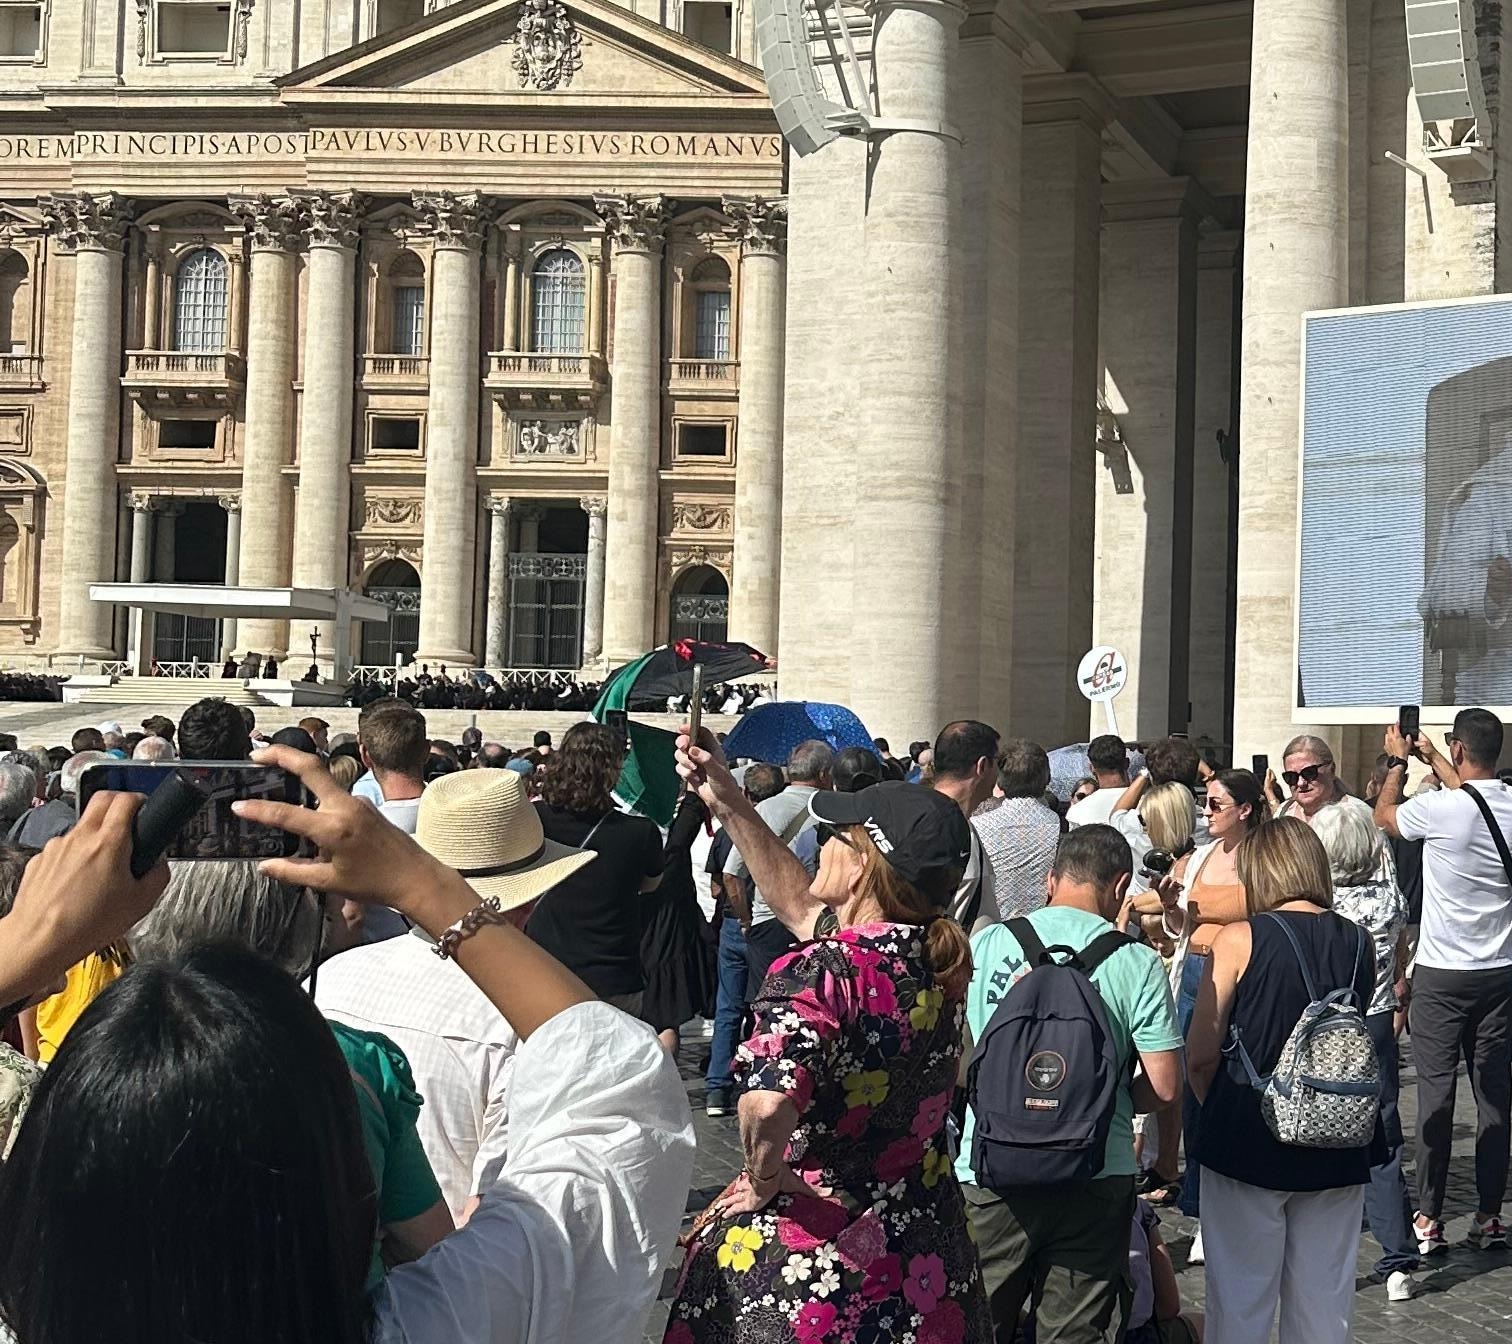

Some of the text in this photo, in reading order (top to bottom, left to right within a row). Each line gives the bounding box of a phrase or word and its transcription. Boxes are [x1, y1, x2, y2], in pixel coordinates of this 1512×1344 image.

[76, 134, 220, 155] PRINCIPIS
[311, 129, 408, 153] PAVLVS
[414, 131, 432, 153] V
[439, 132, 621, 156] BVRGHESIVS
[631, 134, 781, 158] ROMANVS
